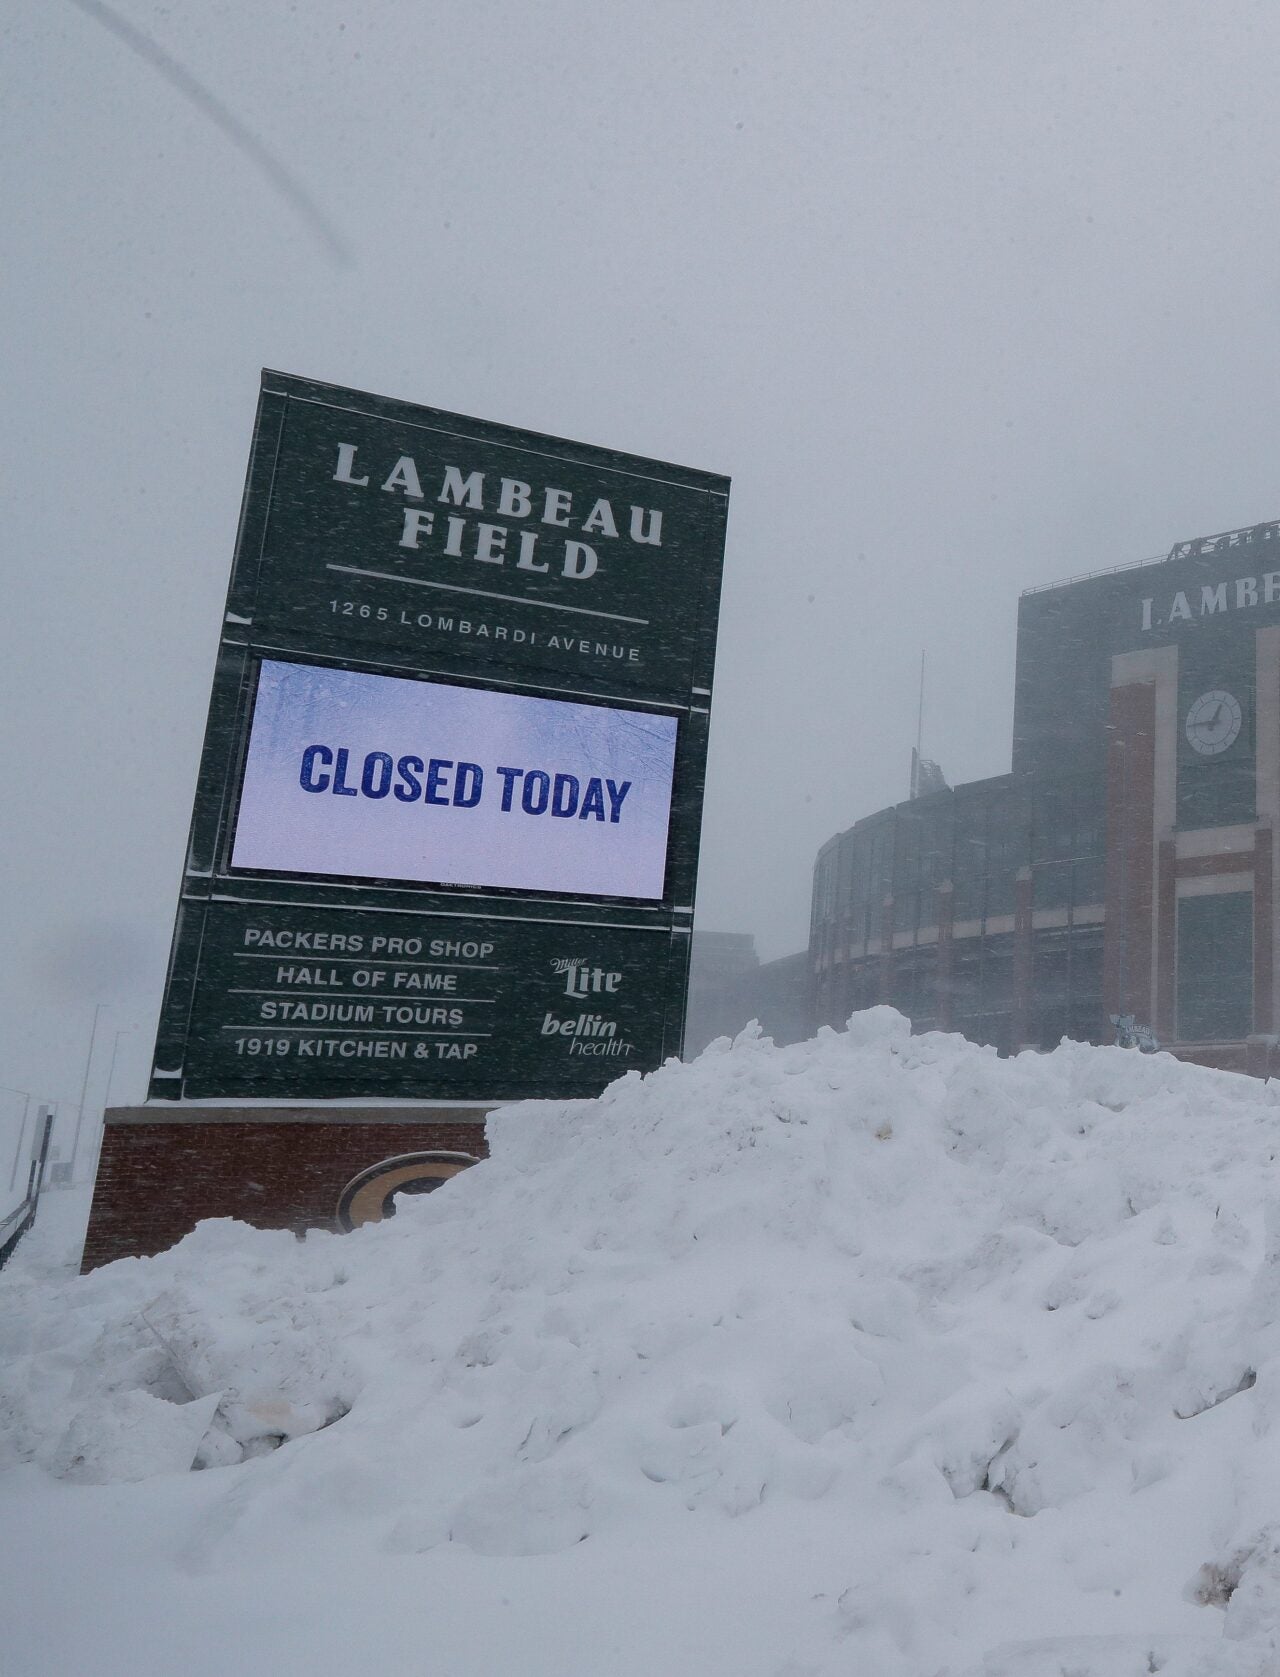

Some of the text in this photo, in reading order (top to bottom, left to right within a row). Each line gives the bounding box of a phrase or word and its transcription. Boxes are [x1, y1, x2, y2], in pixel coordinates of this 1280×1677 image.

[333, 442, 663, 546] LAMBEAU
[399, 508, 599, 580] FIELD
[329, 600, 640, 662] 1265 LOMBARDI AVENUE
[300, 744, 632, 824] CLOSED TODAY
[244, 929, 494, 959] PACKERS PRO SHOP
[276, 967, 457, 991] HALL OF FAME
[563, 966, 622, 999] Lite
[260, 1001, 463, 1025] STADIUM TOURS
[541, 1013, 617, 1037] bellin
[235, 1037, 478, 1060] 1919 KITCHEN & TAP
[569, 1037, 636, 1056] health
